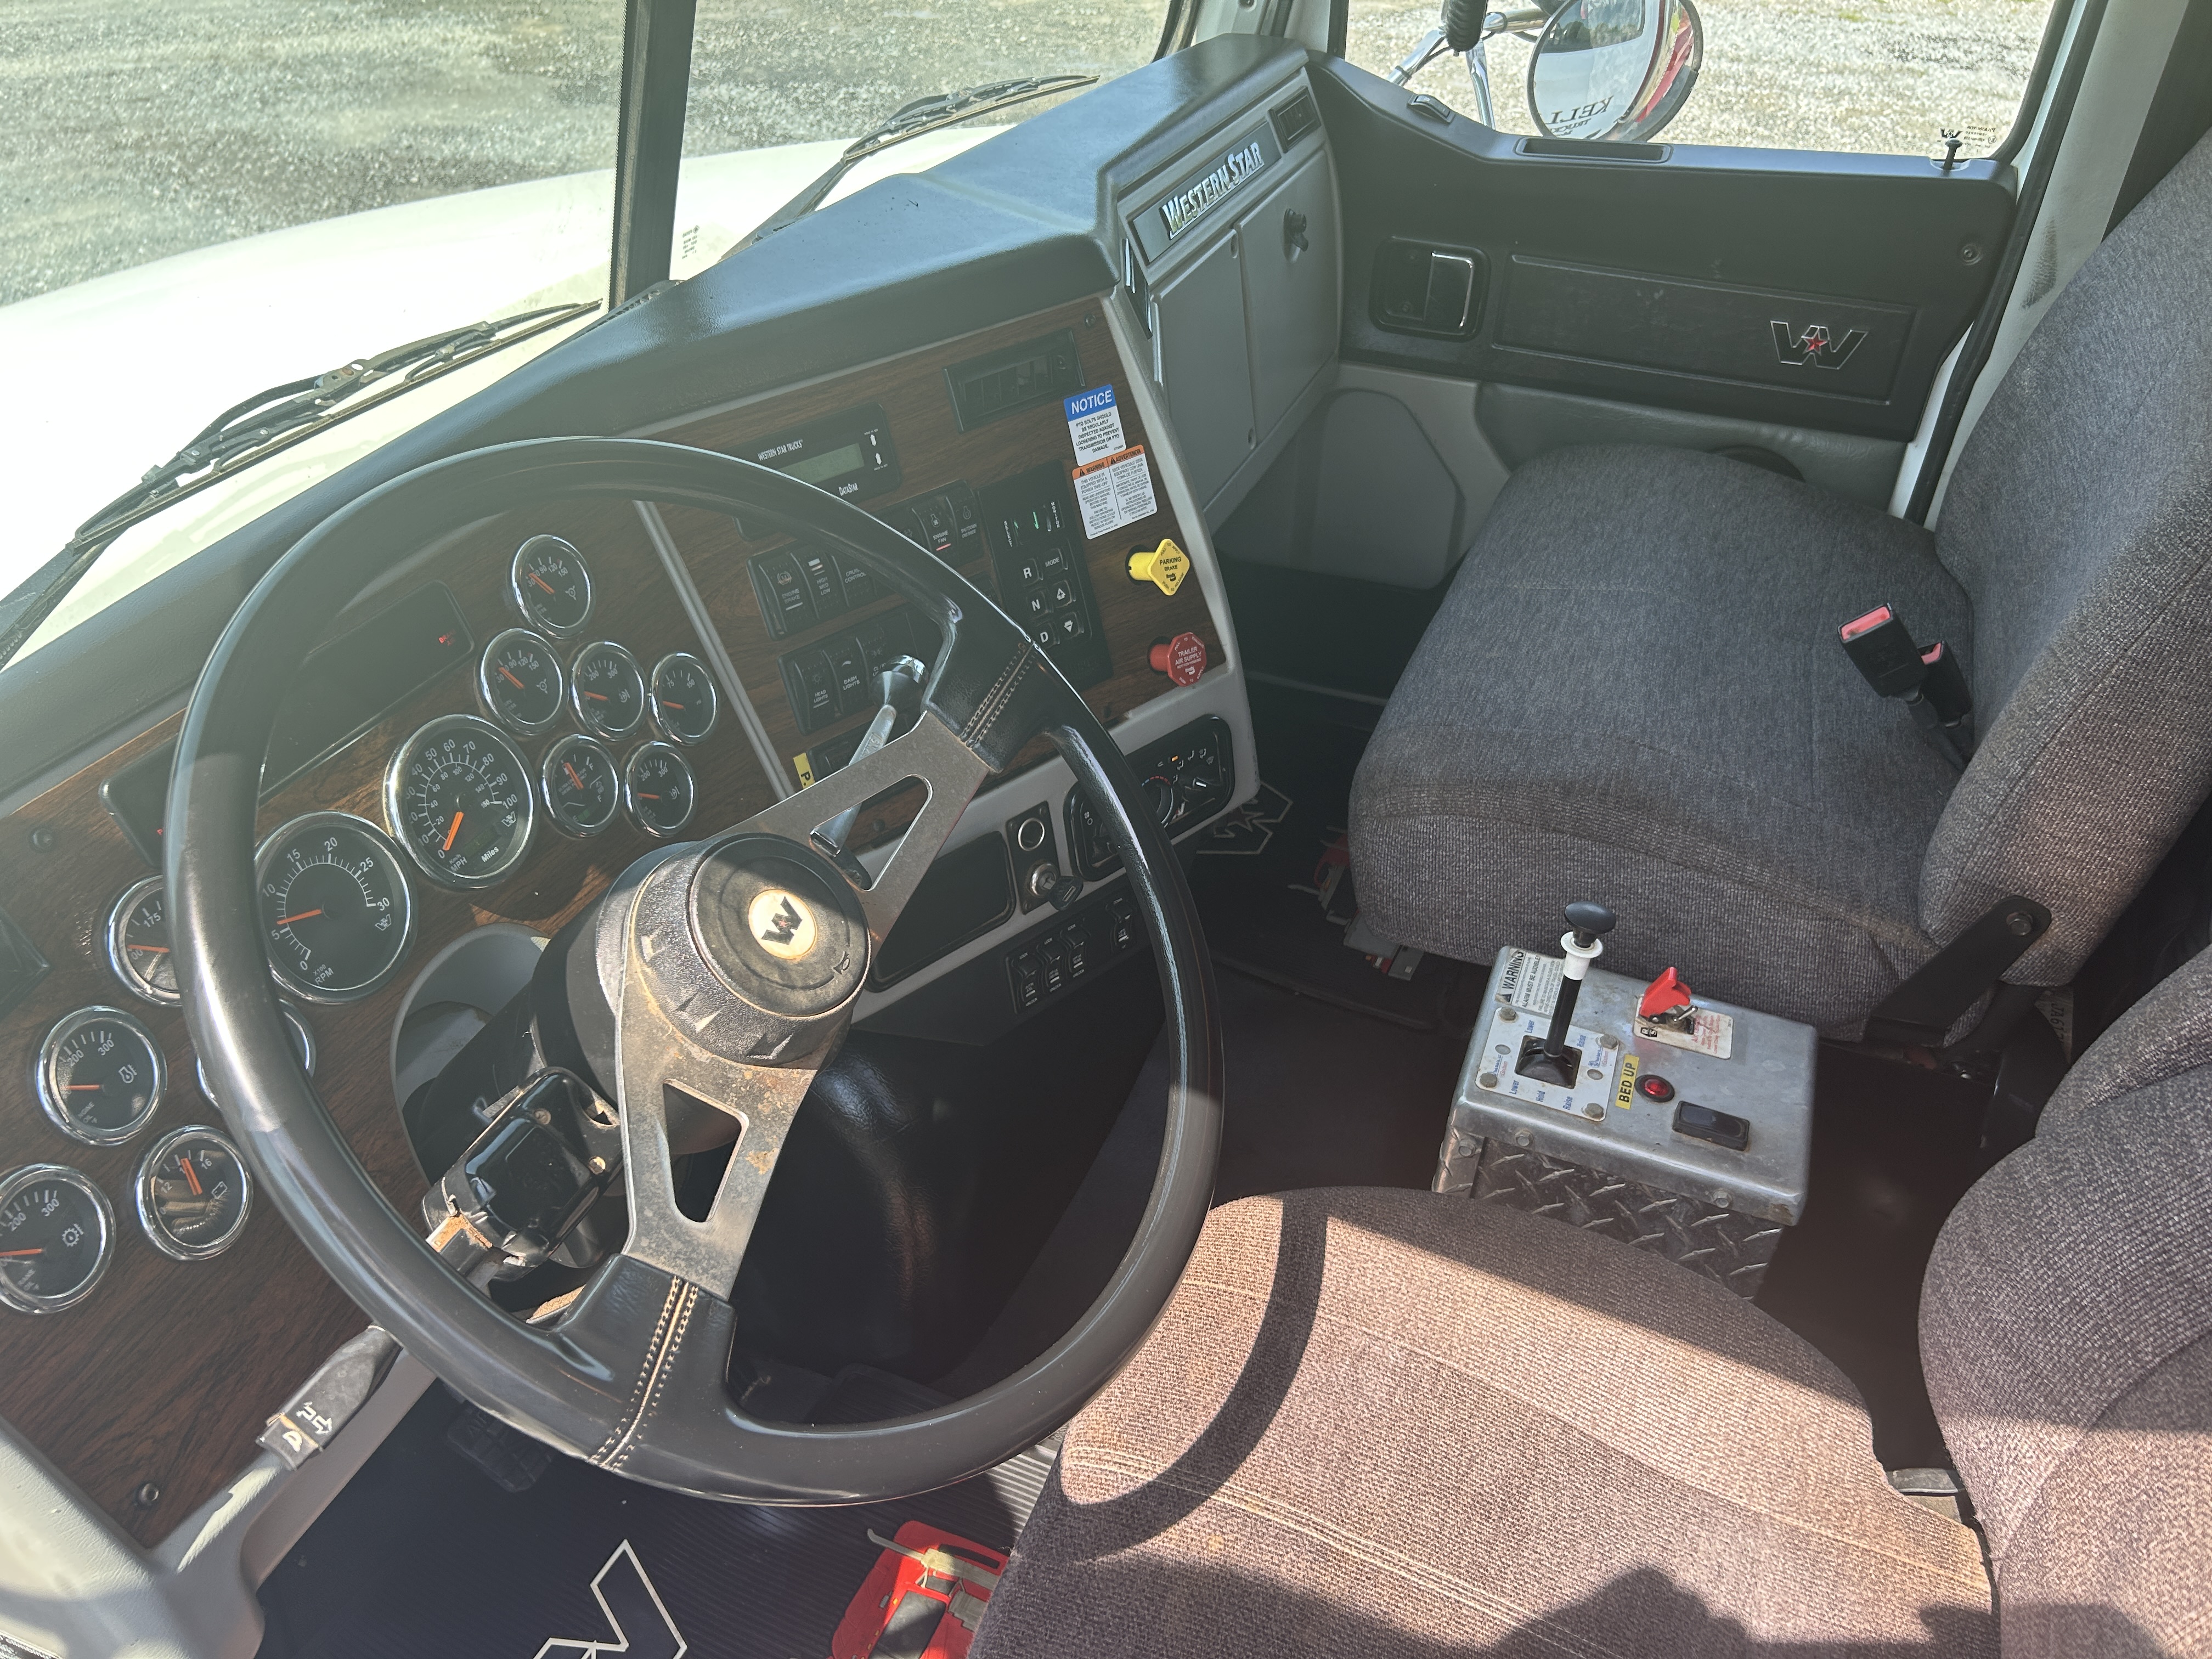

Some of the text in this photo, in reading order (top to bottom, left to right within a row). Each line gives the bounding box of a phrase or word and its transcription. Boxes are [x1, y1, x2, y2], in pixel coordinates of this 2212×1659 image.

[1071, 390, 1113, 415] NOTICE
[1084, 417, 1096, 426] BOLTS
[1097, 412, 1111, 420] SHOULD
[1088, 419, 1109, 430] REGULARLY
[1078, 423, 1114, 439] INSPECTED AGAINST
[1103, 428, 1119, 437] PREVENT
[1079, 439, 1105, 451] TRANSMISSION
[757, 447, 777, 461] WESTERN
[776, 444, 787, 456] STAR
[933, 530, 949, 540] ENGINE
[1045, 556, 1060, 568] MODE
[1159, 556, 1182, 566] PARKING
[539, 565, 548, 574] 90
[549, 563, 558, 573] 120
[558, 567, 568, 577] 150
[1023, 567, 1032, 579] R
[781, 588, 801, 604] ENGINE BRAKE
[1031, 599, 1041, 611] N
[1040, 631, 1048, 643] D
[1178, 646, 1198, 657] TRAILER
[1184, 651, 1202, 662] SUPPLY
[508, 659, 517, 668] 90
[518, 656, 528, 667] 120
[528, 660, 539, 671] 150
[495, 673, 505, 683] 30
[588, 670, 599, 681] 200
[607, 668, 618, 679] 300
[667, 679, 674, 689] 75
[843, 675, 860, 691] DASH LIGHTS
[814, 689, 829, 703] HEAD LIGHTS
[443, 738, 455, 752] 60
[462, 741, 476, 754] 70
[425, 747, 437, 761] 50
[482, 753, 495, 766] 80
[411, 763, 423, 776] 40
[453, 766, 462, 776] 100
[589, 763, 594, 771] F
[658, 766, 668, 777] 300
[440, 772, 449, 780] 80
[465, 773, 475, 782] 120
[495, 772, 508, 786] 90
[640, 770, 651, 781] 200
[432, 783, 441, 792] 60
[475, 784, 485, 793] 140
[430, 799, 438, 808] 40
[502, 794, 518, 809] 100
[597, 794, 602, 803] F
[436, 816, 444, 825] 20
[324, 837, 338, 851] 20
[417, 833, 430, 847] 10
[286, 848, 301, 863] 15
[437, 849, 445, 859] 0
[481, 847, 499, 863] Miles
[360, 857, 374, 872] 25
[450, 857, 467, 872] MPH
[263, 883, 276, 897] 10
[377, 897, 390, 912] 30
[144, 912, 161, 928] 175
[271, 929, 280, 940] 5
[1044, 937, 1053, 945] LOCK
[130, 949, 144, 960] 00
[1019, 952, 1029, 960] LOCK
[300, 960, 308, 970] 0
[313, 964, 327, 977] X100
[1502, 951, 1524, 990] WARNING
[314, 967, 334, 986] RPM
[1524, 1019, 1535, 1034] Lower
[97, 1039, 115, 1056] 300
[1576, 1035, 1587, 1048] Raise
[66, 1049, 84, 1067] 200
[1509, 1080, 1520, 1095] Lower
[1618, 1062, 1635, 1103] BED UP
[1536, 1090, 1545, 1103] Hold
[1562, 1096, 1573, 1110] Raise
[77, 1101, 95, 1119] NGINE
[201, 1158, 212, 1170] 16
[161, 1182, 173, 1194] 12
[41, 1198, 60, 1217] 300
[7, 1212, 26, 1232] 200
